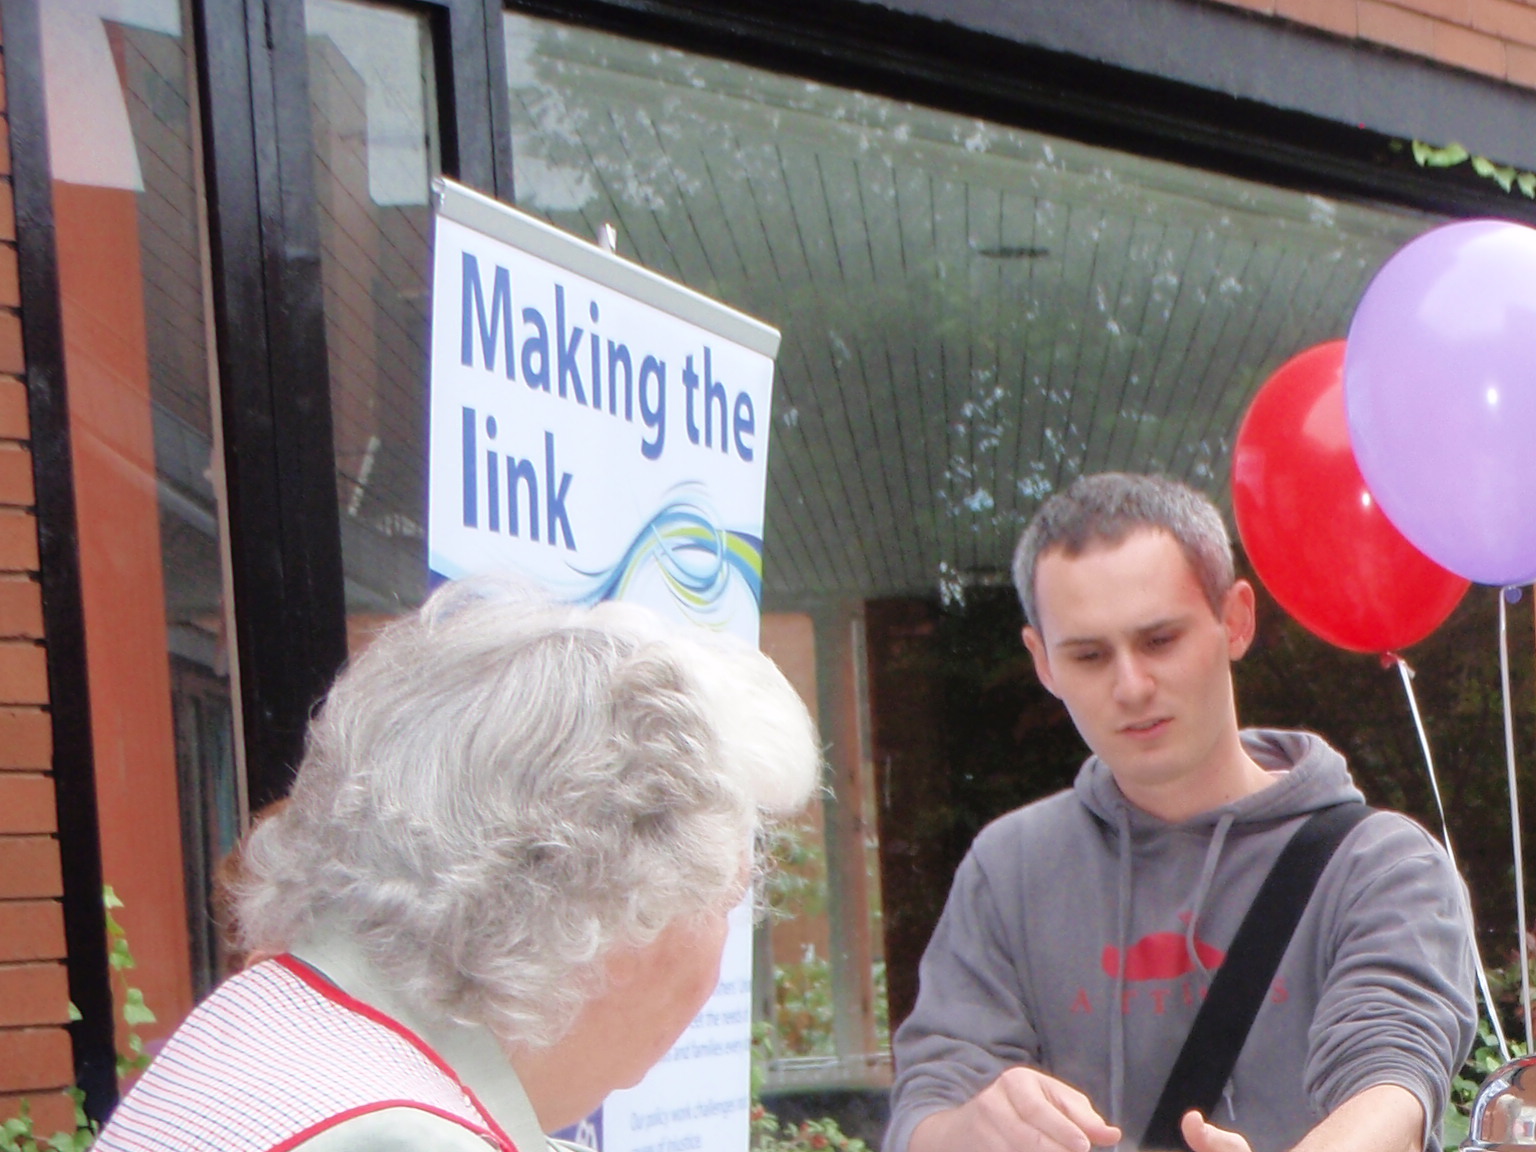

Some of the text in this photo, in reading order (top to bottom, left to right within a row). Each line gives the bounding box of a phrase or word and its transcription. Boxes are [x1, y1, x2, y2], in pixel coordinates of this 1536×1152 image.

[460, 249, 757, 463] Making the
[461, 406, 578, 553] link
